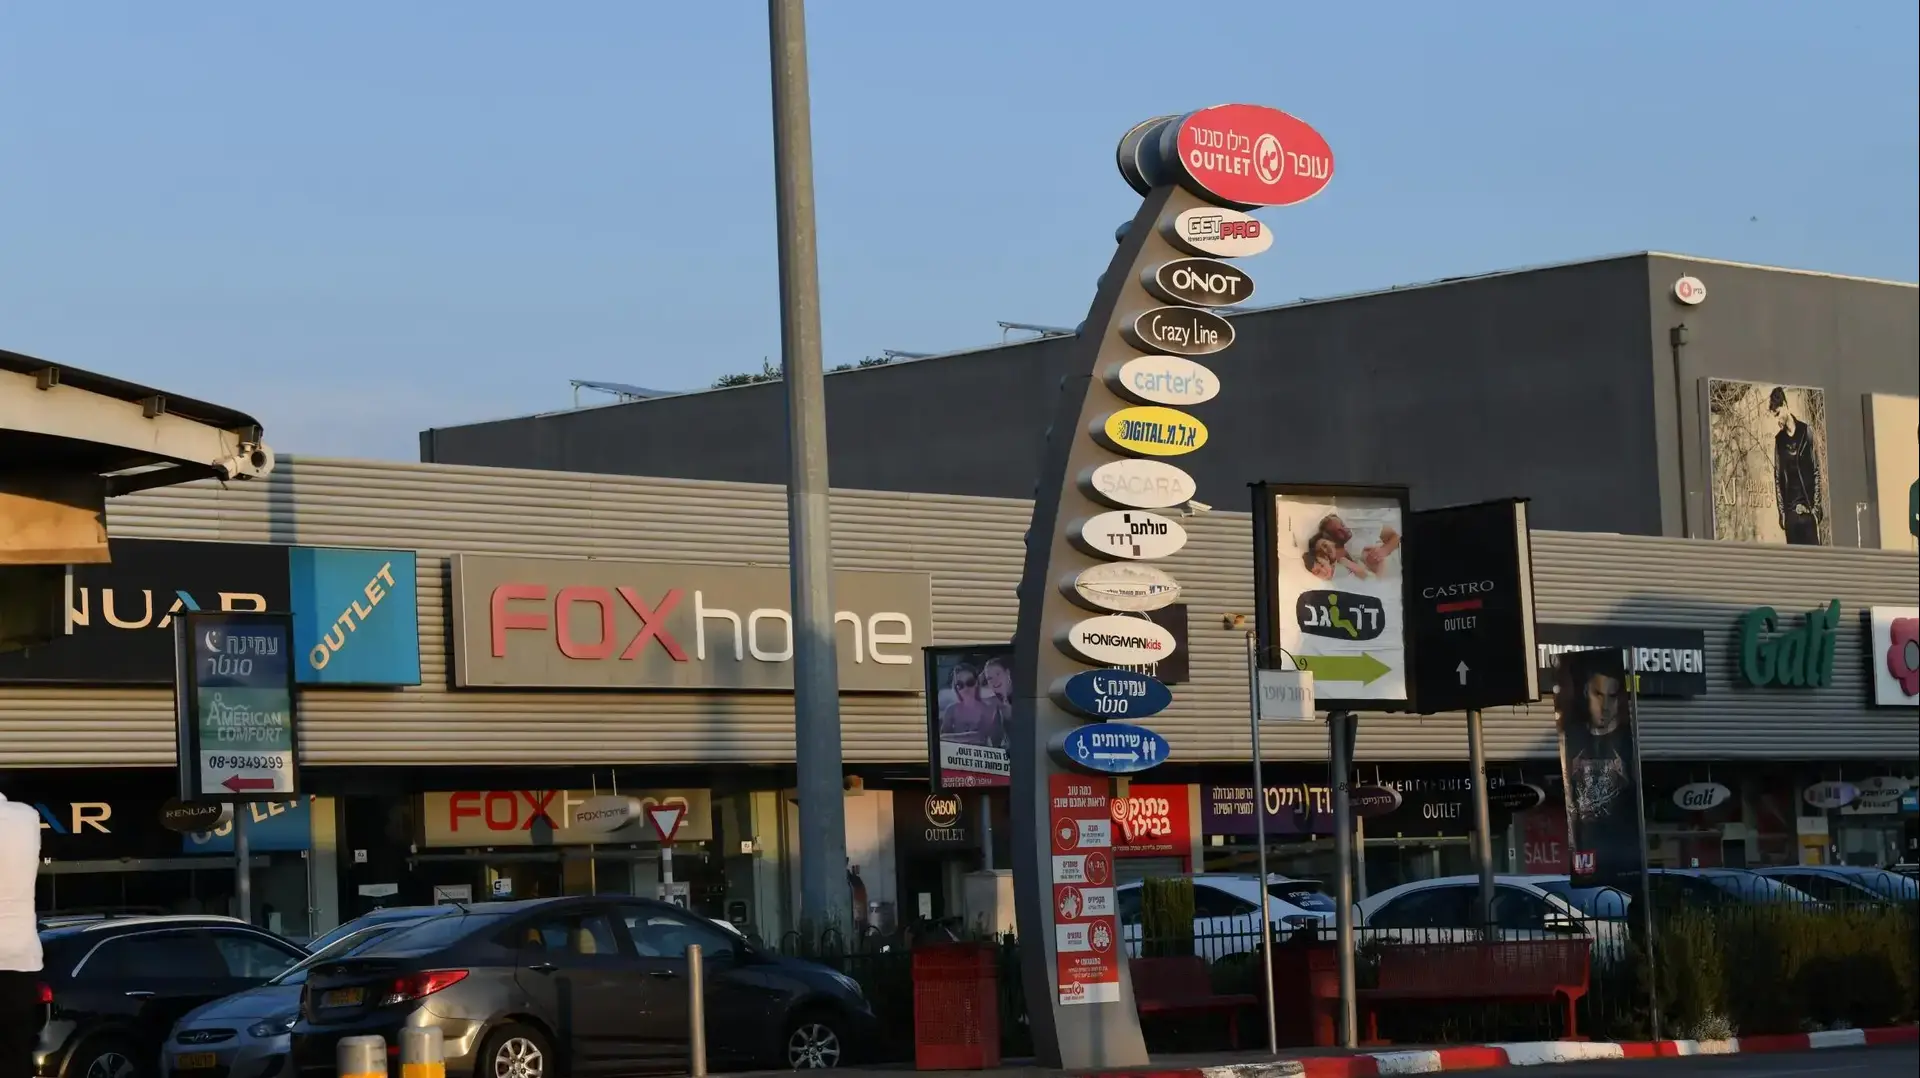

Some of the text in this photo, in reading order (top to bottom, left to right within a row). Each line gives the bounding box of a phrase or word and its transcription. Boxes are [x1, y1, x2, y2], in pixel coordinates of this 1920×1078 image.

[1189, 126, 1251, 152] בילו סנטר
[1189, 149, 1251, 177] OUTLET
[1286, 151, 1329, 179] עופר
[1152, 314, 1218, 347] Crazy Line
[1133, 369, 1204, 396] carter's
[1101, 473, 1184, 497] SACARA
[1130, 518, 1168, 535] סולתם
[1422, 579, 1495, 599] CASTRO
[309, 560, 398, 672] OUTLET
[1303, 603, 1332, 628] גב
[1444, 615, 1477, 632] OUTLET
[226, 635, 278, 656] עמינח
[1739, 598, 1842, 689] Gali
[207, 654, 253, 676] סנטר
[1107, 679, 1146, 697] עמינח
[1263, 686, 1312, 702] רחוב עופר
[206, 700, 283, 726] AMERICAN
[1094, 695, 1129, 713] סנטר
[217, 726, 284, 743] COMFORT
[1092, 733, 1141, 748] שירותים
[208, 755, 284, 770] 08-9349299
[947, 756, 973, 767] OUTLET
[1235, 787, 1253, 800] הרשת
[1682, 788, 1715, 806] Gali
[165, 805, 217, 819] RENUAR
[930, 799, 957, 816] SABON
[1128, 797, 1169, 821] מתוק
[1423, 802, 1462, 819] OUTLET
[925, 828, 965, 842] OUTLET
[1132, 815, 1172, 837] בבילו
[1523, 841, 1562, 864] SALE
